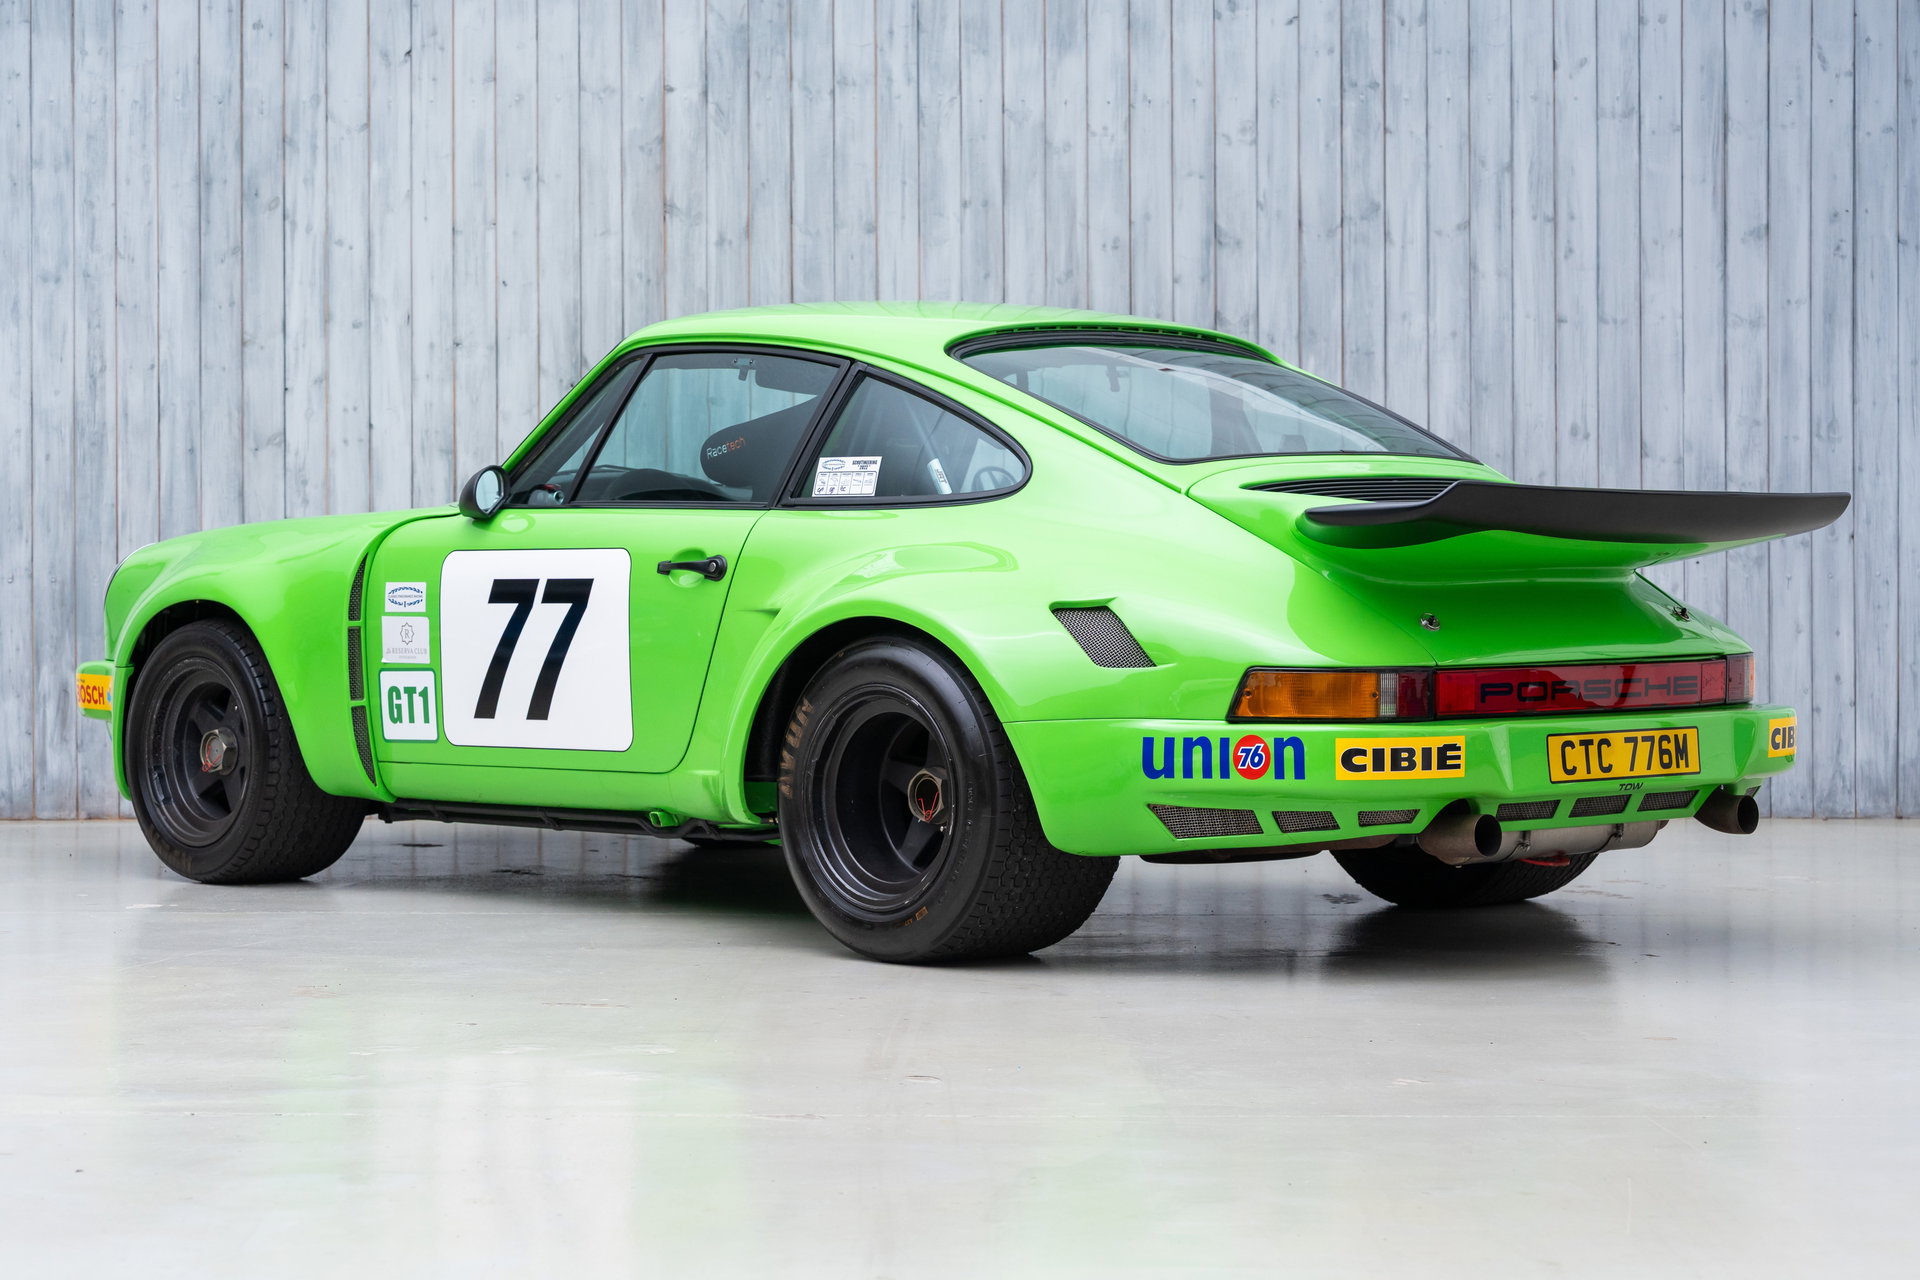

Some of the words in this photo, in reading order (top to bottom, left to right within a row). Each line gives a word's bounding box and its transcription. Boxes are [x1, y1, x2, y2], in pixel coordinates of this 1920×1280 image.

[706, 435, 746, 460] Racetech
[474, 578, 595, 721] 77
[387, 686, 430, 724] GT1
[1480, 676, 1698, 704] PORSCHE
[1237, 744, 1266, 769] 76
[1340, 743, 1462, 773] CIBIÉ
[1560, 737, 1613, 776] CTC
[1624, 733, 1690, 772] 776M
